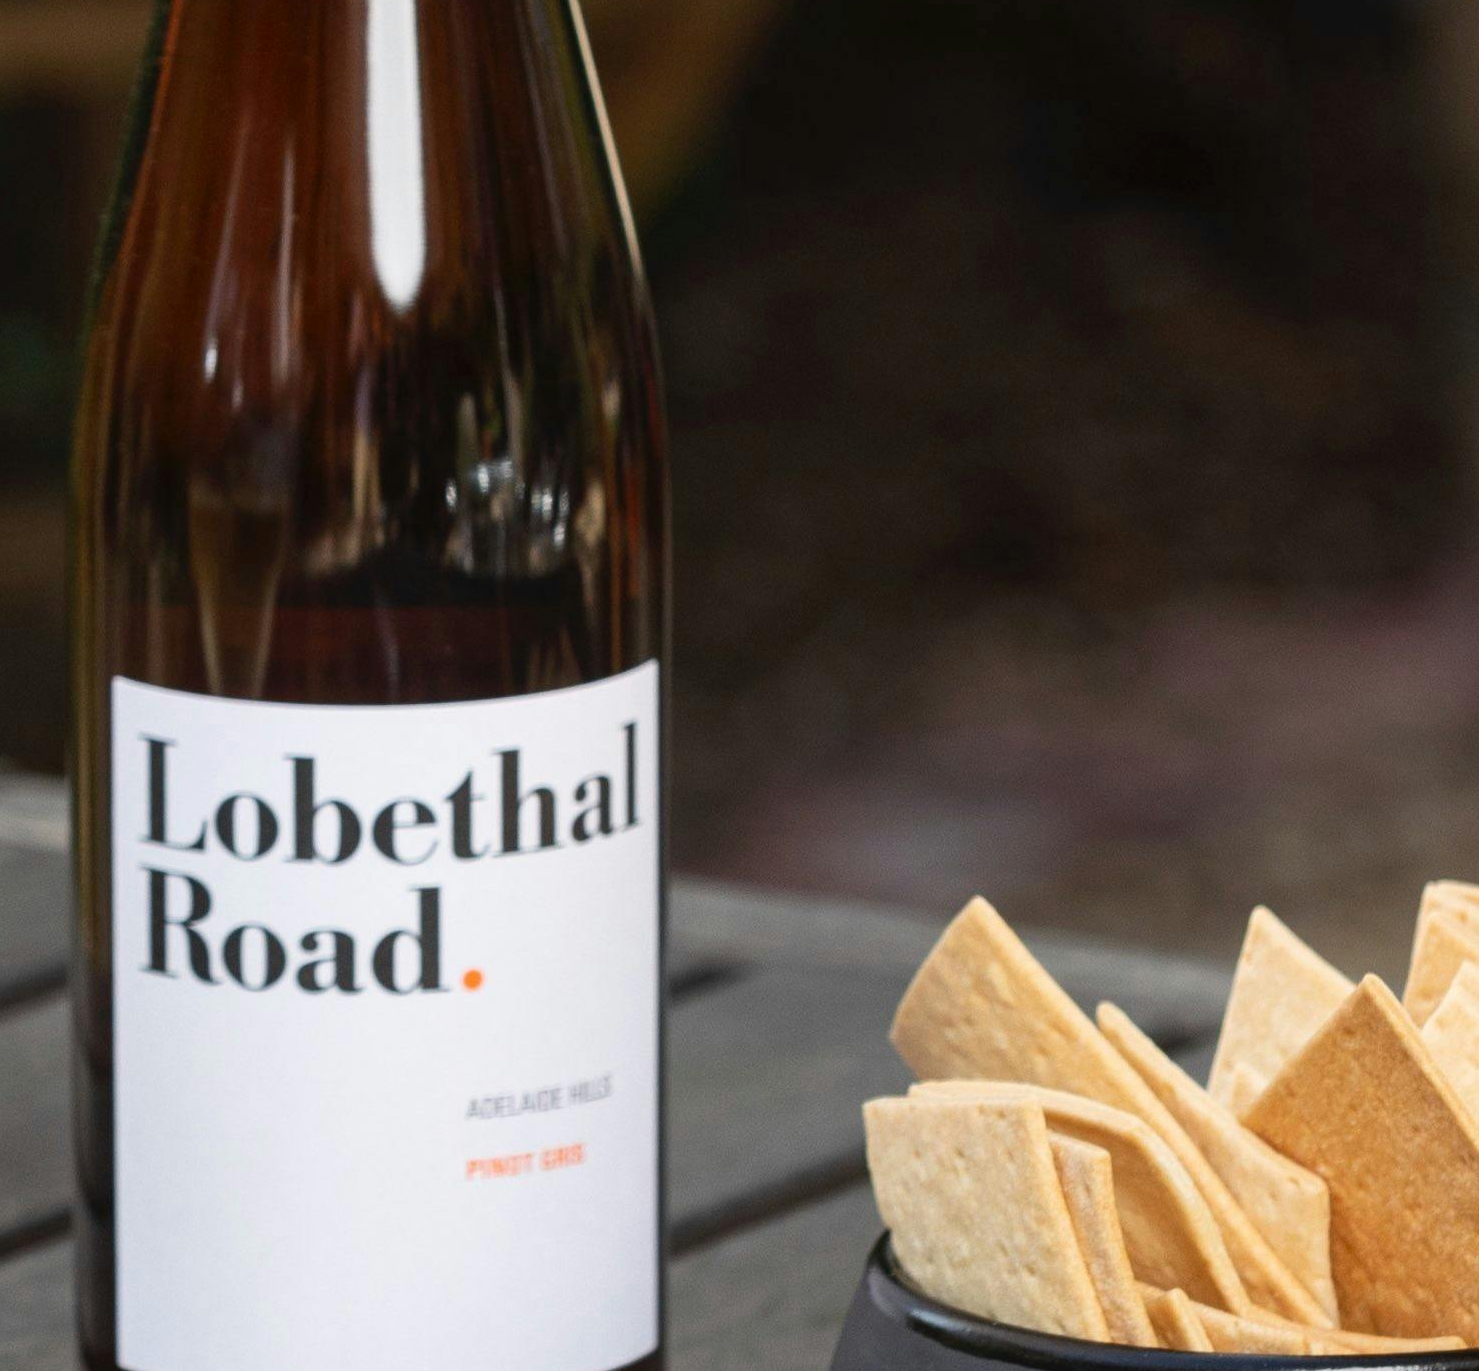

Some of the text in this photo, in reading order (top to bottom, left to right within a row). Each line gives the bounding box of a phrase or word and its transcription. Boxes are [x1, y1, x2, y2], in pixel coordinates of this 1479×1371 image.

[140, 720, 642, 866] Lobethal
[140, 865, 483, 996] Road.
[465, 1087, 563, 1119] ADELAIDE
